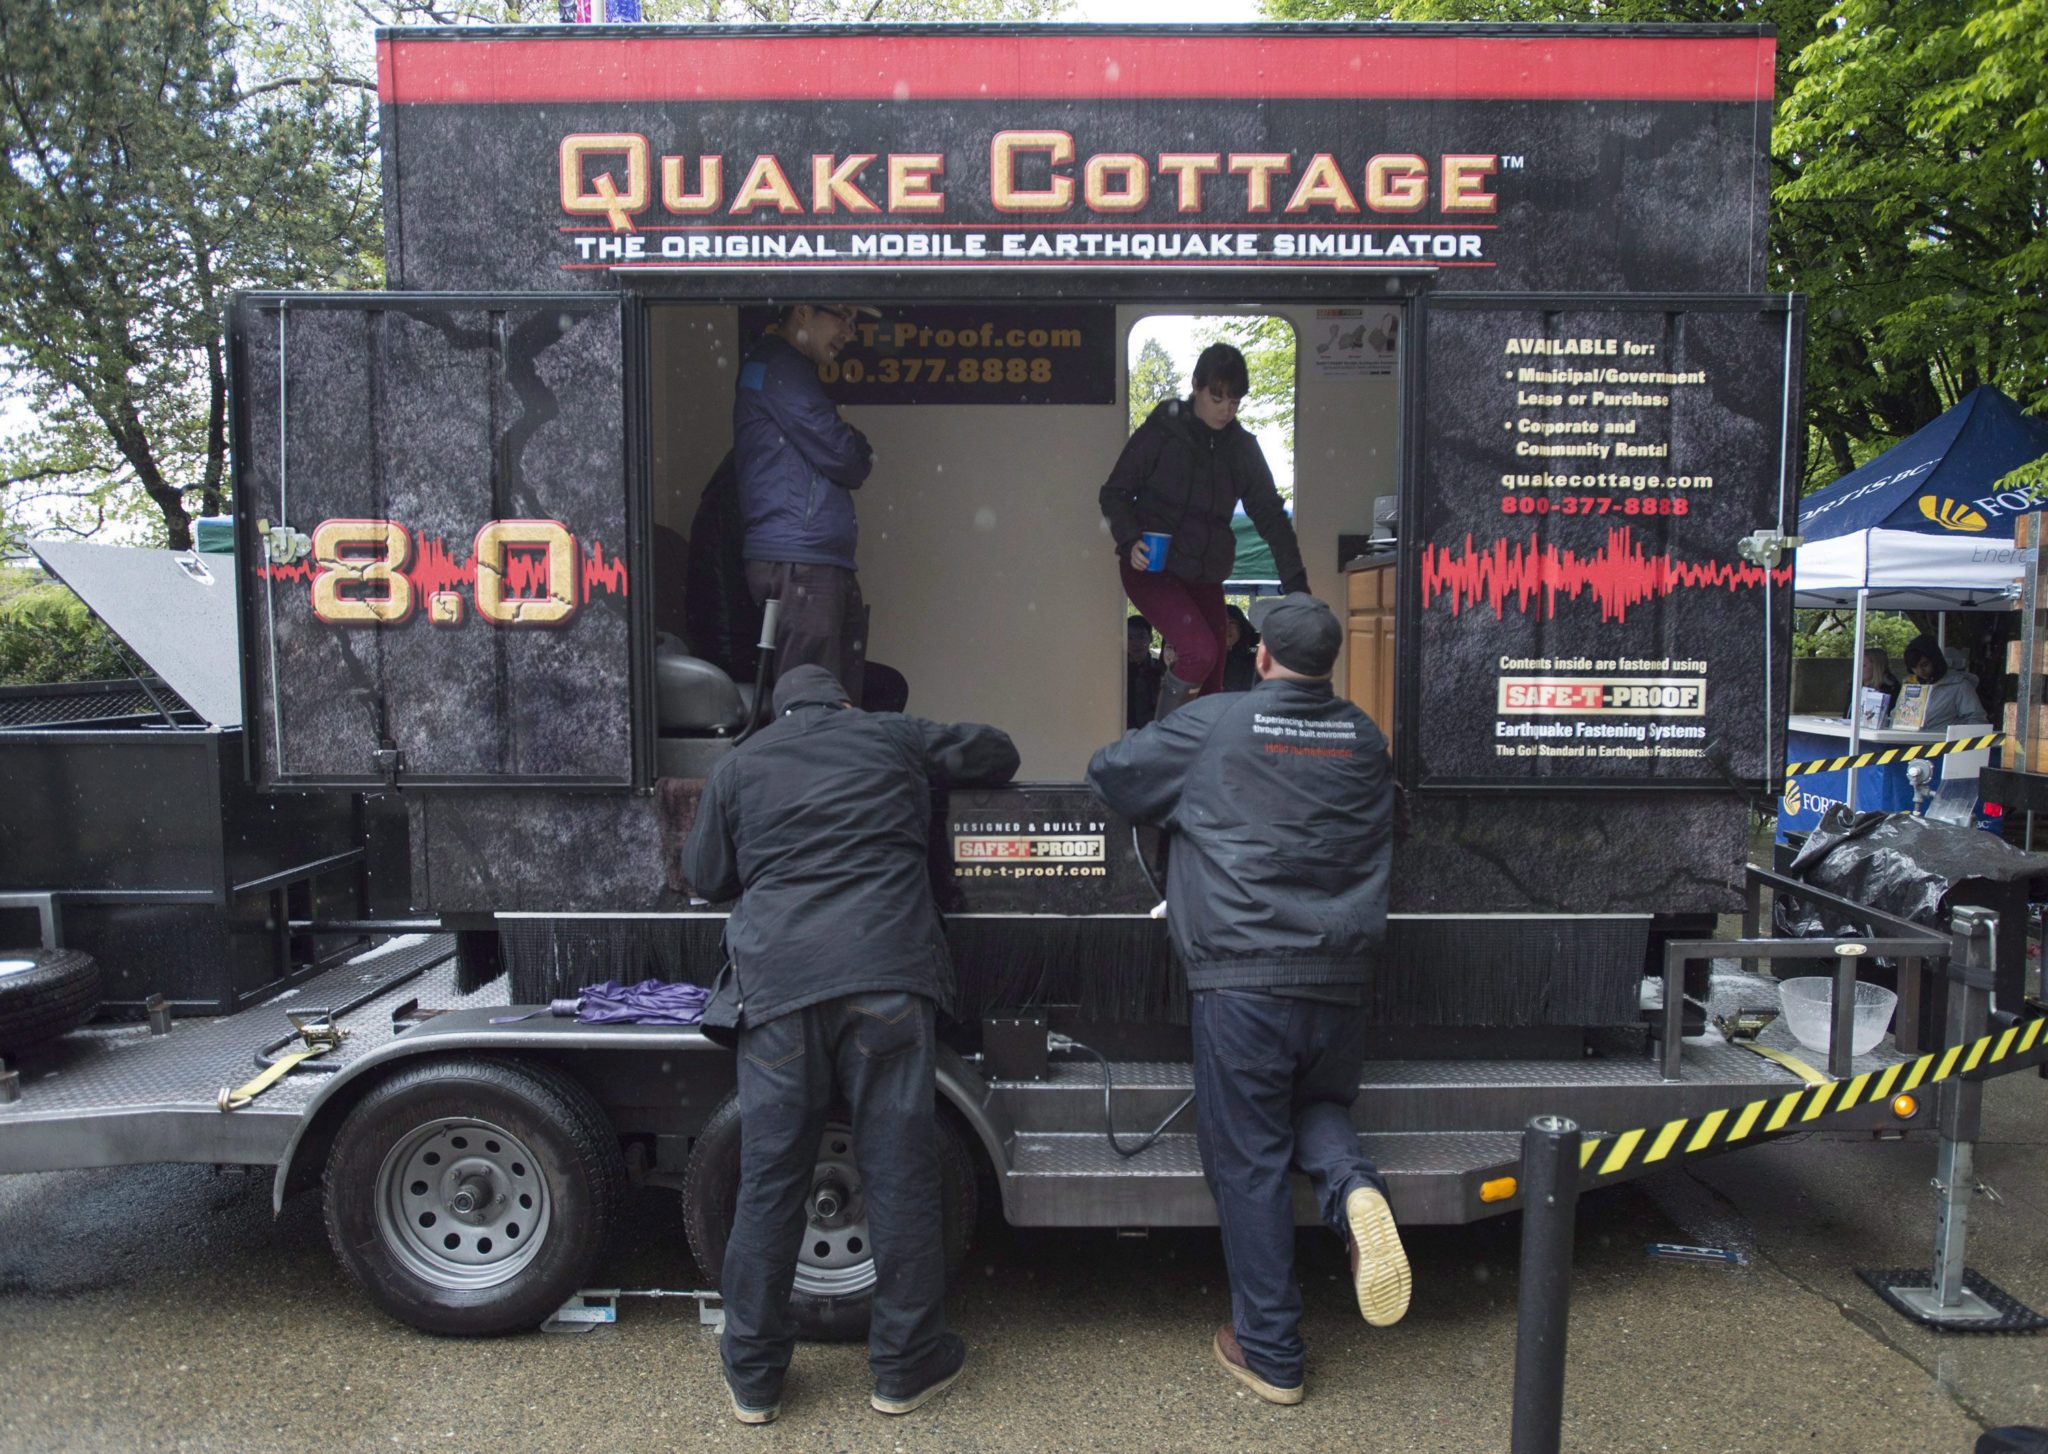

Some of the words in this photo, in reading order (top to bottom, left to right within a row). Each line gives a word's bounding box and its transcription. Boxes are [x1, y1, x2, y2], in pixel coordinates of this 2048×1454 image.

[559, 132, 945, 233] QUAKE
[991, 129, 1497, 213] COTTAGE
[574, 236, 646, 258] THE
[661, 235, 837, 258] ORIGINAL
[851, 234, 986, 257] MOBILE
[1002, 233, 1258, 259] EARTHQUAKE
[1273, 234, 1482, 258] SIMULATOR
[764, 322, 1082, 348] -T-Proof.com
[1505, 338, 1618, 355] AVAILABLE
[1623, 341, 1655, 355] for:
[817, 357, 1053, 384] 00.377.8888
[1517, 368, 1706, 385] Municipal/Government
[1517, 391, 1563, 406] Lease
[1568, 394, 1587, 406] or
[1592, 391, 1669, 406] Purchase
[1517, 419, 1599, 436] Corporate
[1604, 420, 1636, 434] and
[1516, 441, 1610, 459] Community
[1615, 442, 1668, 457] Rental
[1501, 473, 1713, 490] quakecottage.com
[1501, 496, 1689, 515] 800-377-8888
[311, 518, 578, 625] 8.0
[1500, 656, 1552, 670] Contents
[1554, 657, 1593, 670] inside
[1595, 660, 1616, 670] are
[1618, 657, 1669, 670] fastened
[1672, 658, 1707, 674] using
[1253, 724, 1284, 737] through
[1285, 728, 1298, 736] the
[1299, 729, 1316, 738] built
[1496, 721, 1573, 740] Earthquake
[1576, 722, 1645, 741] Fastening
[1648, 722, 1706, 741] Systems
[1495, 744, 1515, 756] The
[1539, 744, 1584, 756] Standard
[1587, 745, 1597, 756] in
[954, 822, 1021, 832] DESIGNED
[1028, 823, 1036, 832] &
[1044, 822, 1082, 832] BUILT
[1089, 822, 1106, 832] BY
[954, 865, 1107, 878] safe-t-proof.com
